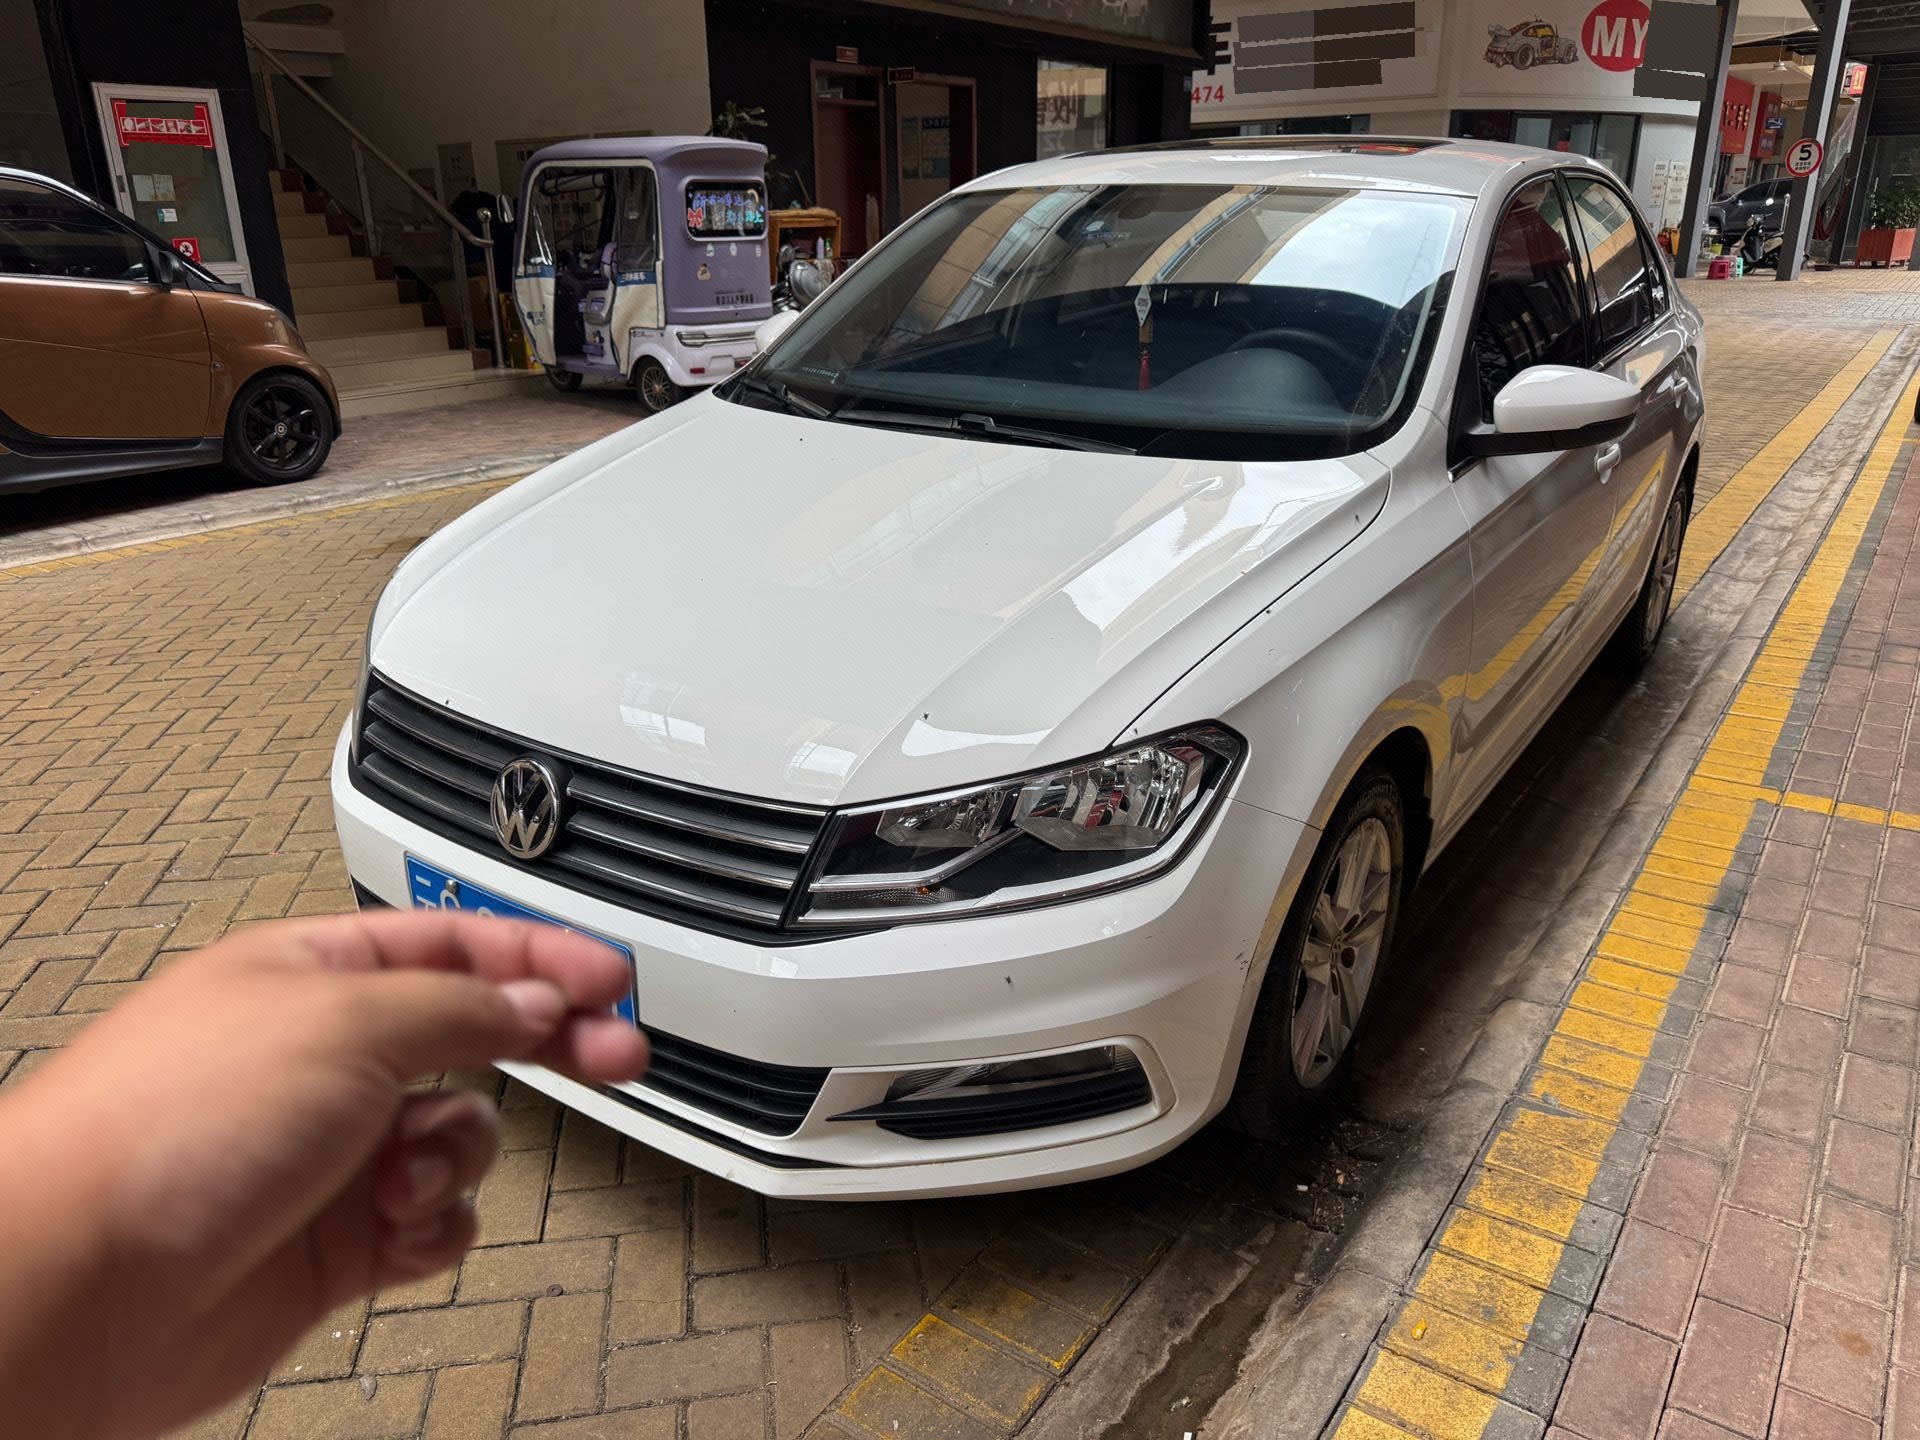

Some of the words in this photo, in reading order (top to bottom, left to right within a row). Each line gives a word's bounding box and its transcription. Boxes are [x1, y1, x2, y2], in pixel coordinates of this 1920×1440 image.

[1591, 15, 1649, 59] MY
[1191, 85, 1224, 103] 474
[1799, 144, 1812, 160] 5
